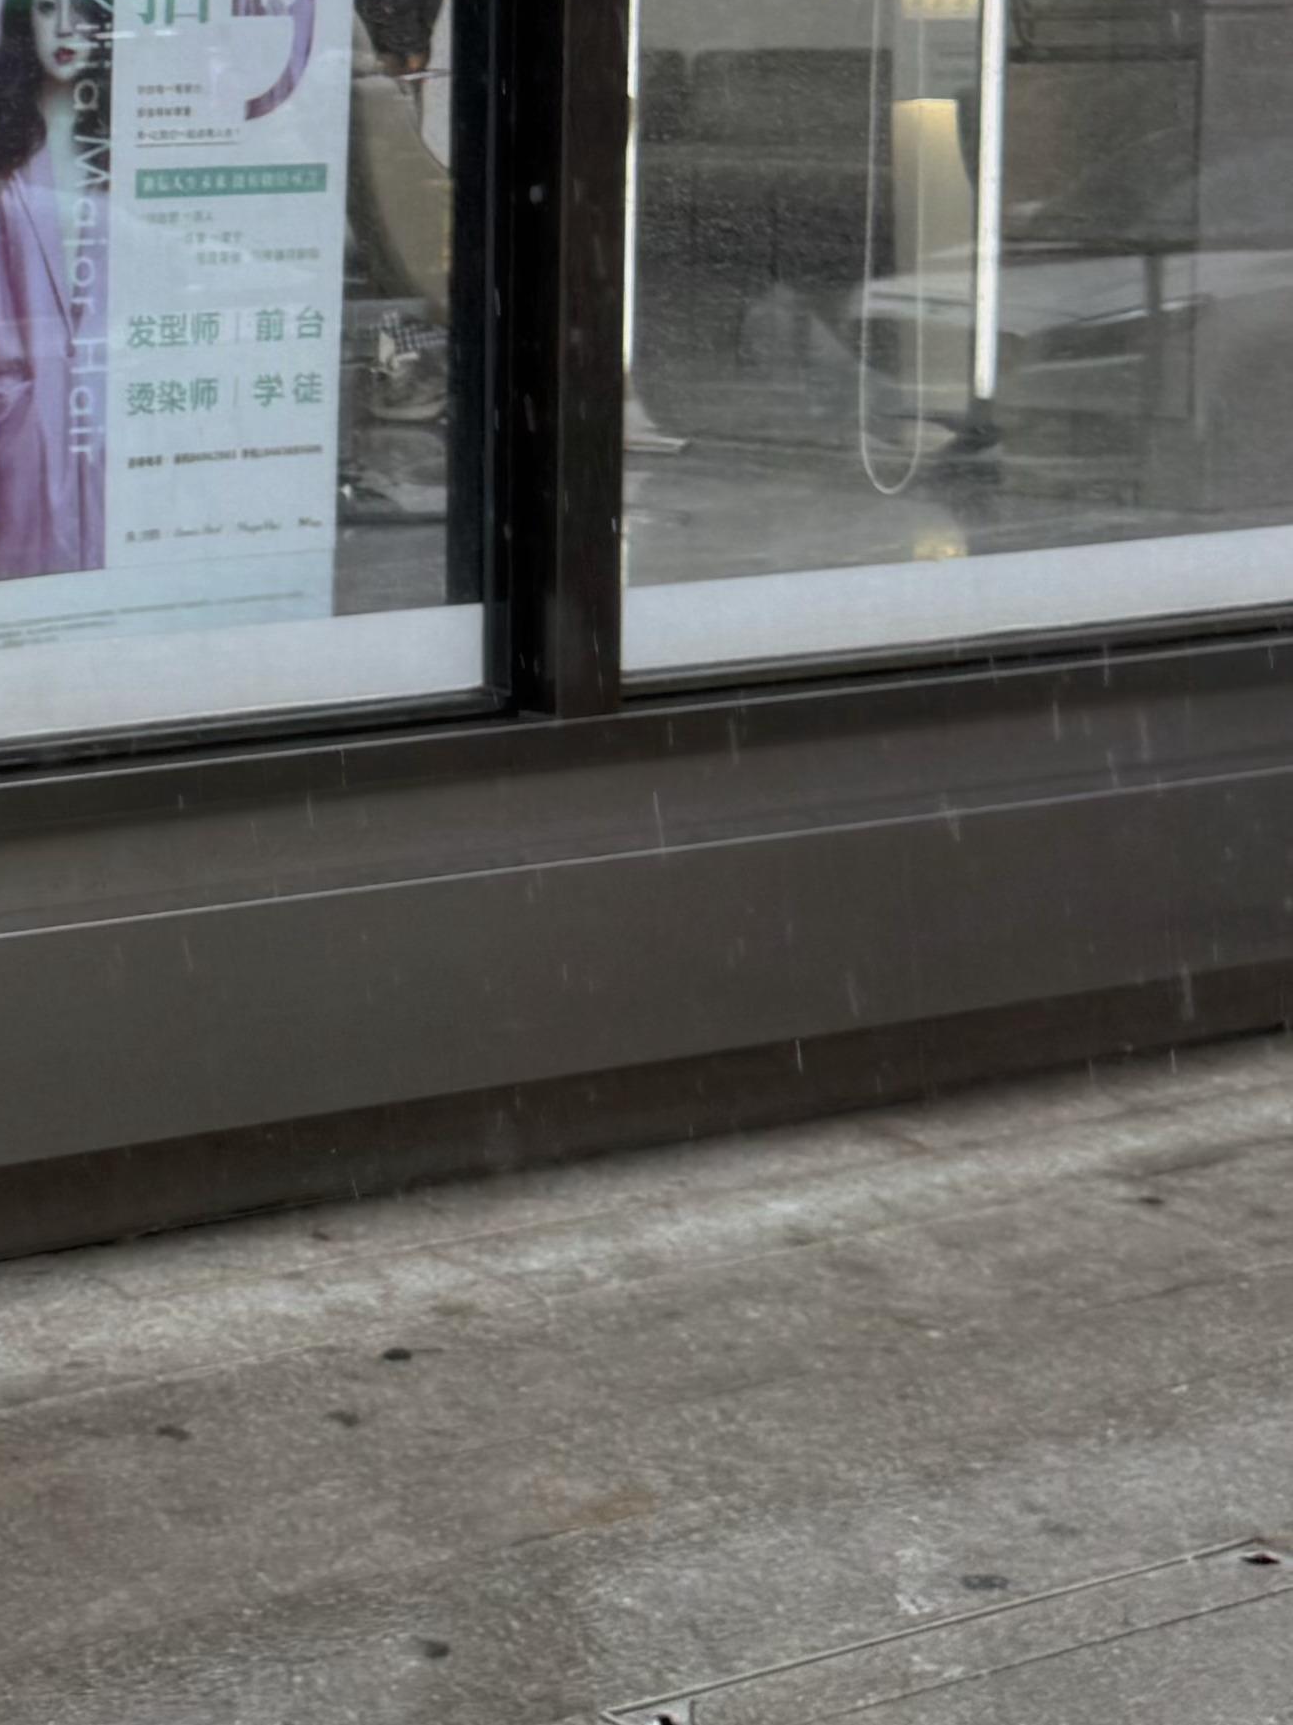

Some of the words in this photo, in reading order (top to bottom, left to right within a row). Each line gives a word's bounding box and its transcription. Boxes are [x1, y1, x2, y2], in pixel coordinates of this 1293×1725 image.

[64, 135, 112, 315] Major
[127, 311, 222, 349] 发型师
[254, 305, 325, 342] 前台
[68, 337, 110, 463] Hair
[126, 377, 220, 416] 烫染师
[253, 371, 324, 408] 学徒
